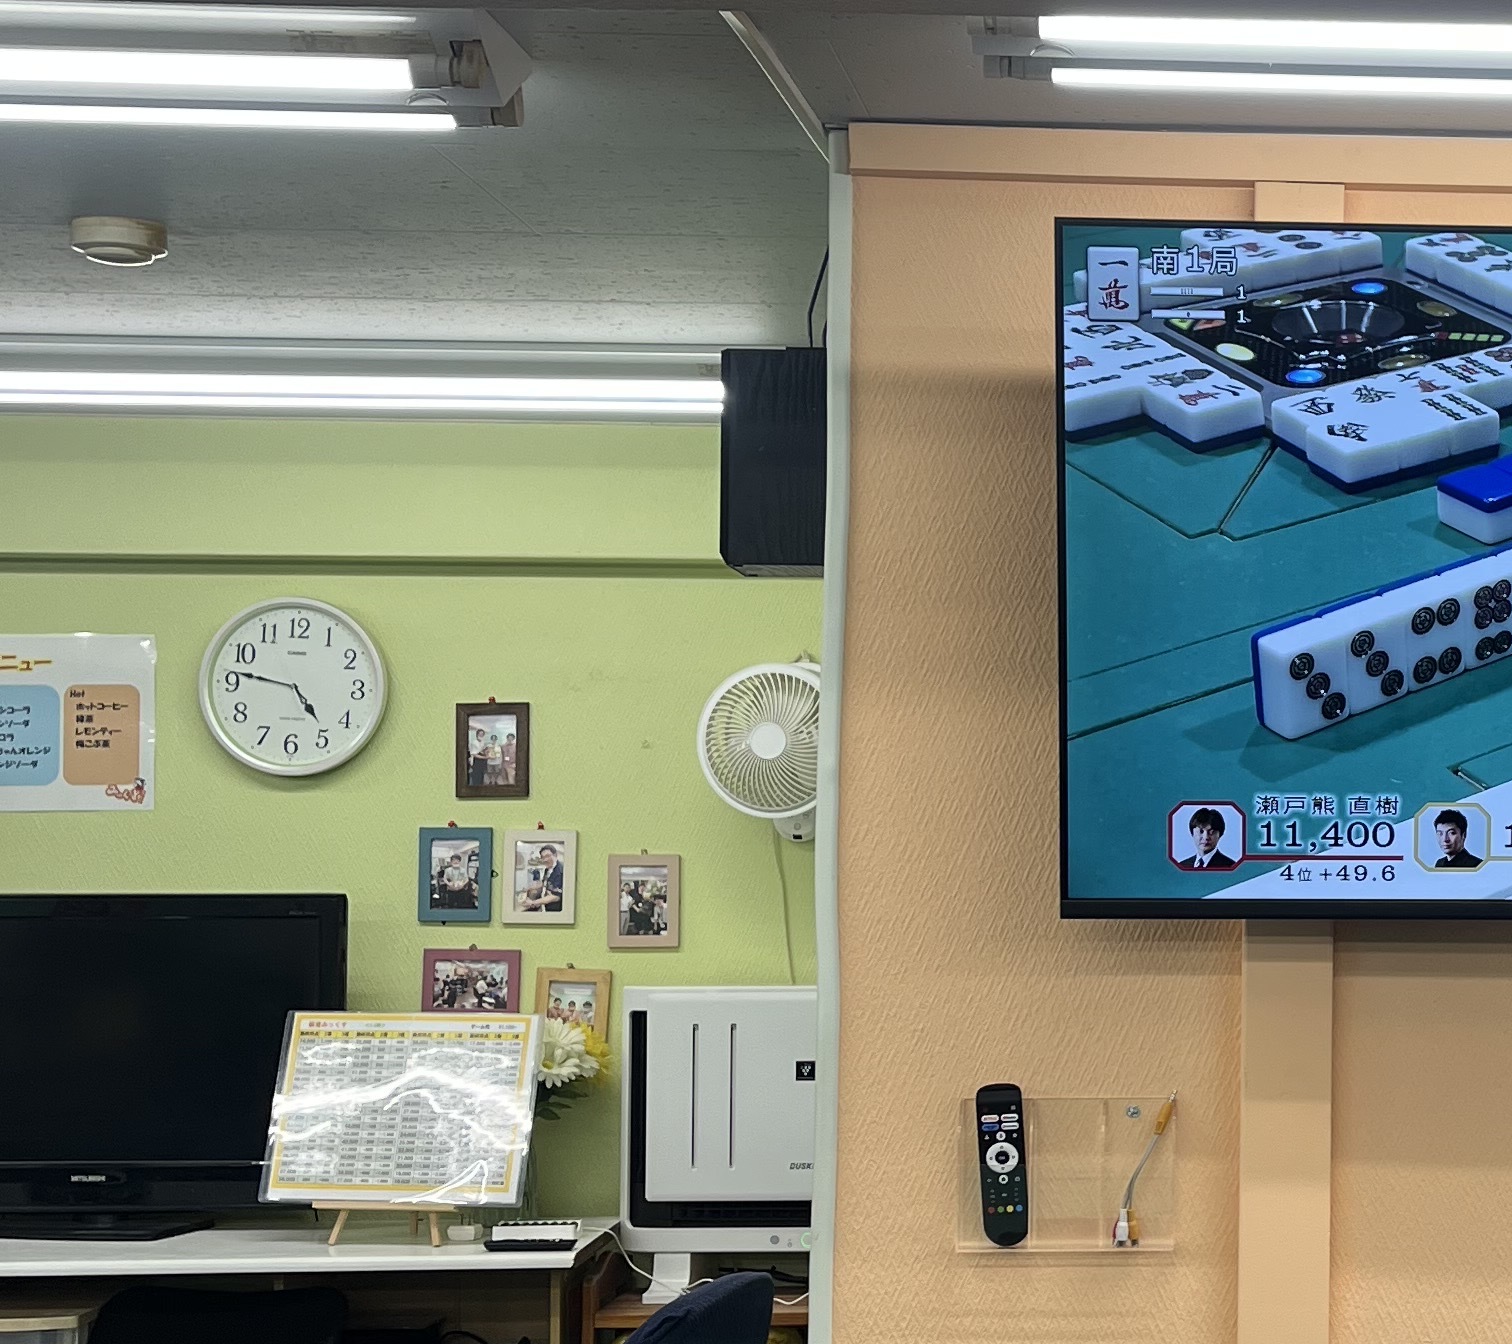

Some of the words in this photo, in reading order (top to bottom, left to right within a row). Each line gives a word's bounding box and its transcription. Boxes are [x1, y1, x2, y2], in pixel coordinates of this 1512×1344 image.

[1151, 246, 1237, 275] 南1局
[261, 623, 277, 644] 11
[288, 618, 310, 639] 12
[325, 627, 332, 647] 1
[235, 643, 256, 664] 10
[343, 649, 357, 670] 2
[225, 671, 239, 692] 9
[350, 679, 365, 700] 3
[233, 702, 247, 723] 8
[338, 709, 352, 729] 4
[256, 726, 270, 745] 7
[283, 733, 298, 755] 6
[315, 728, 329, 749] 5
[1348, 796, 1399, 815] 直樹
[1260, 821, 1395, 852] 11,400
